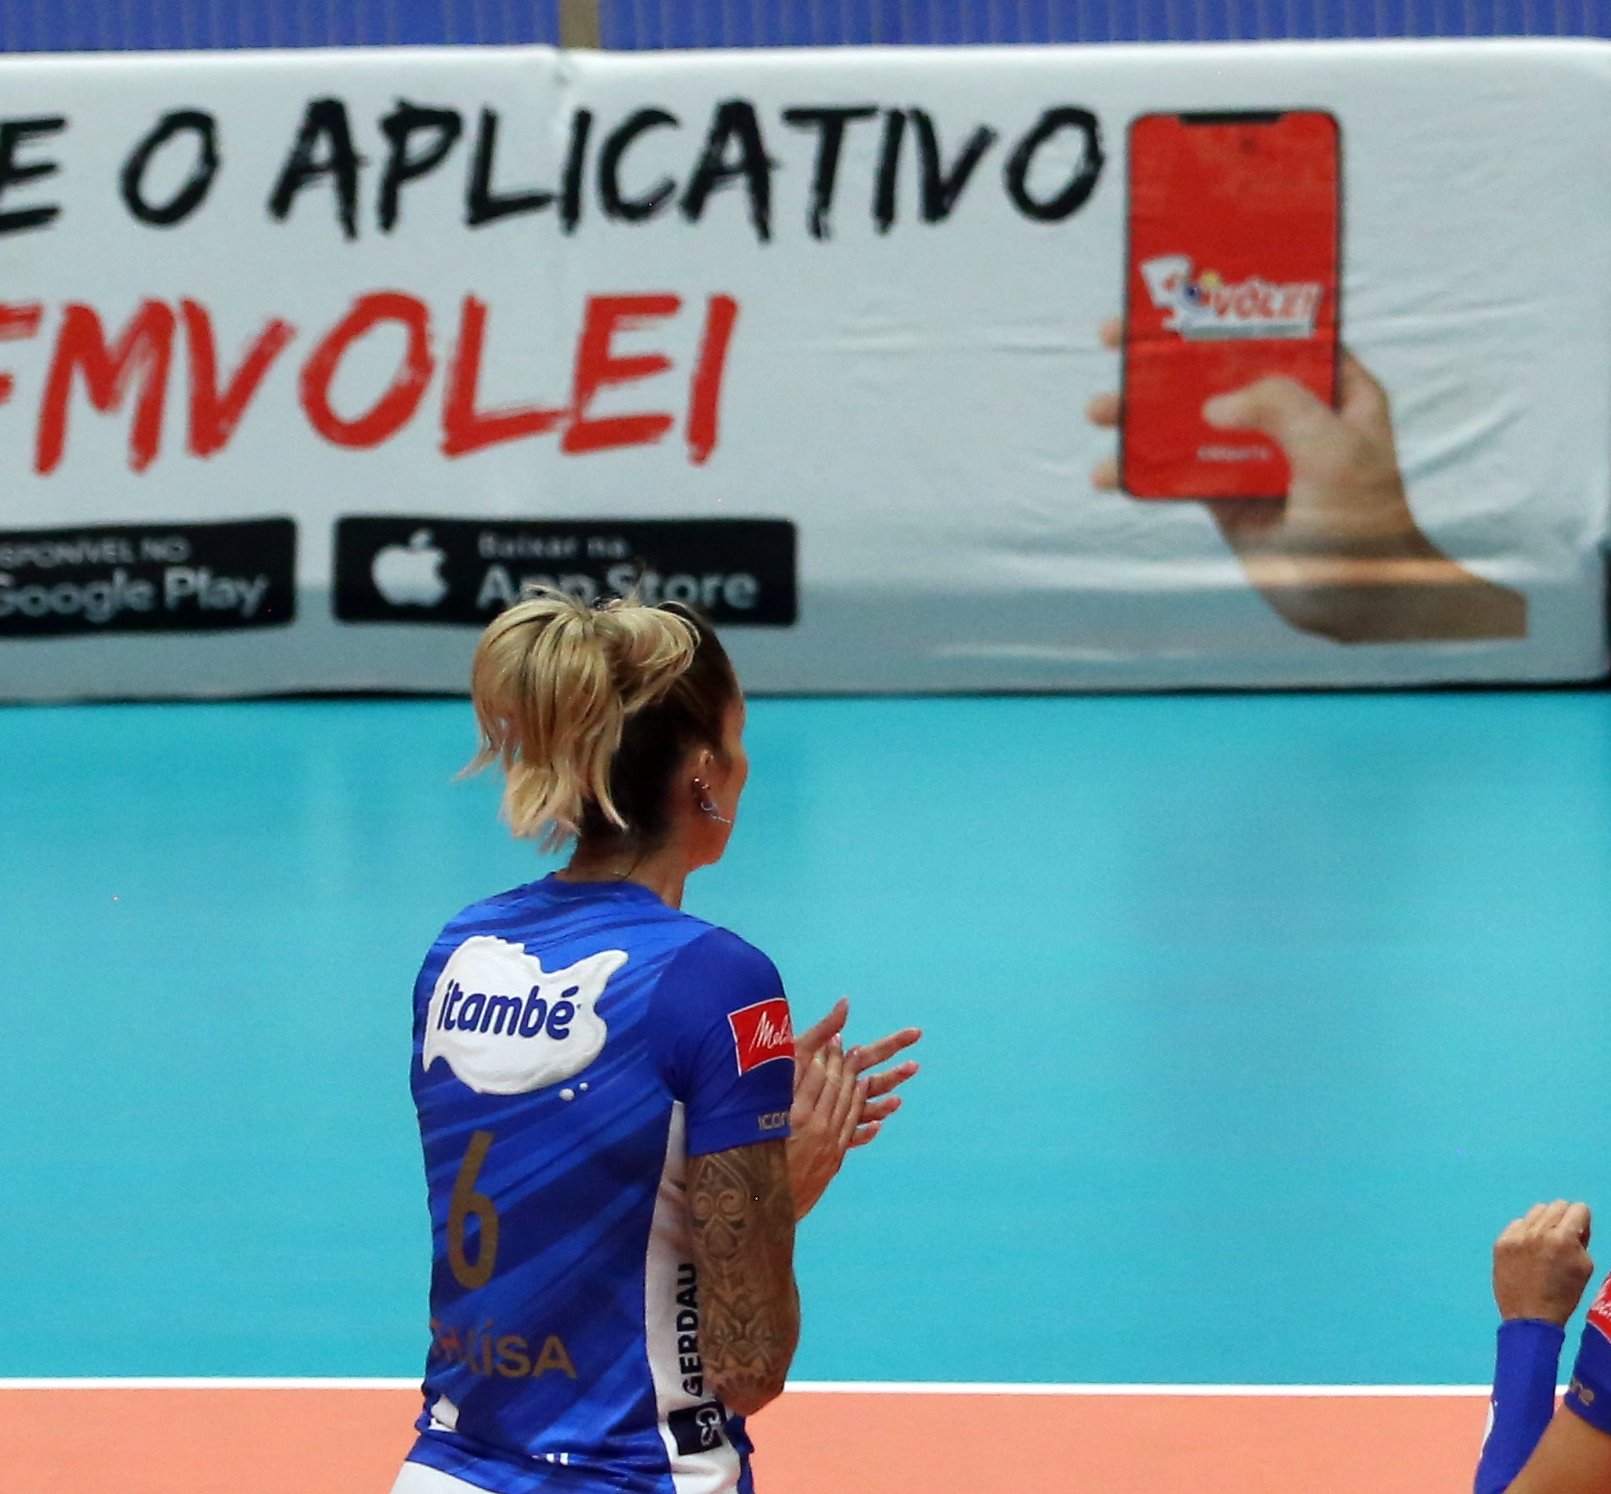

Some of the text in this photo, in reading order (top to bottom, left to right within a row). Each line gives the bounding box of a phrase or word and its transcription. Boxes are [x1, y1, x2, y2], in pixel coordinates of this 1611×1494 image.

[121, 108, 222, 229] O
[267, 94, 1105, 244] APLICATIVO
[163, 566, 270, 618] Play
[436, 981, 580, 1040] itambé
[446, 1131, 500, 1290] 6
[676, 1262, 704, 1398] GERDAU
